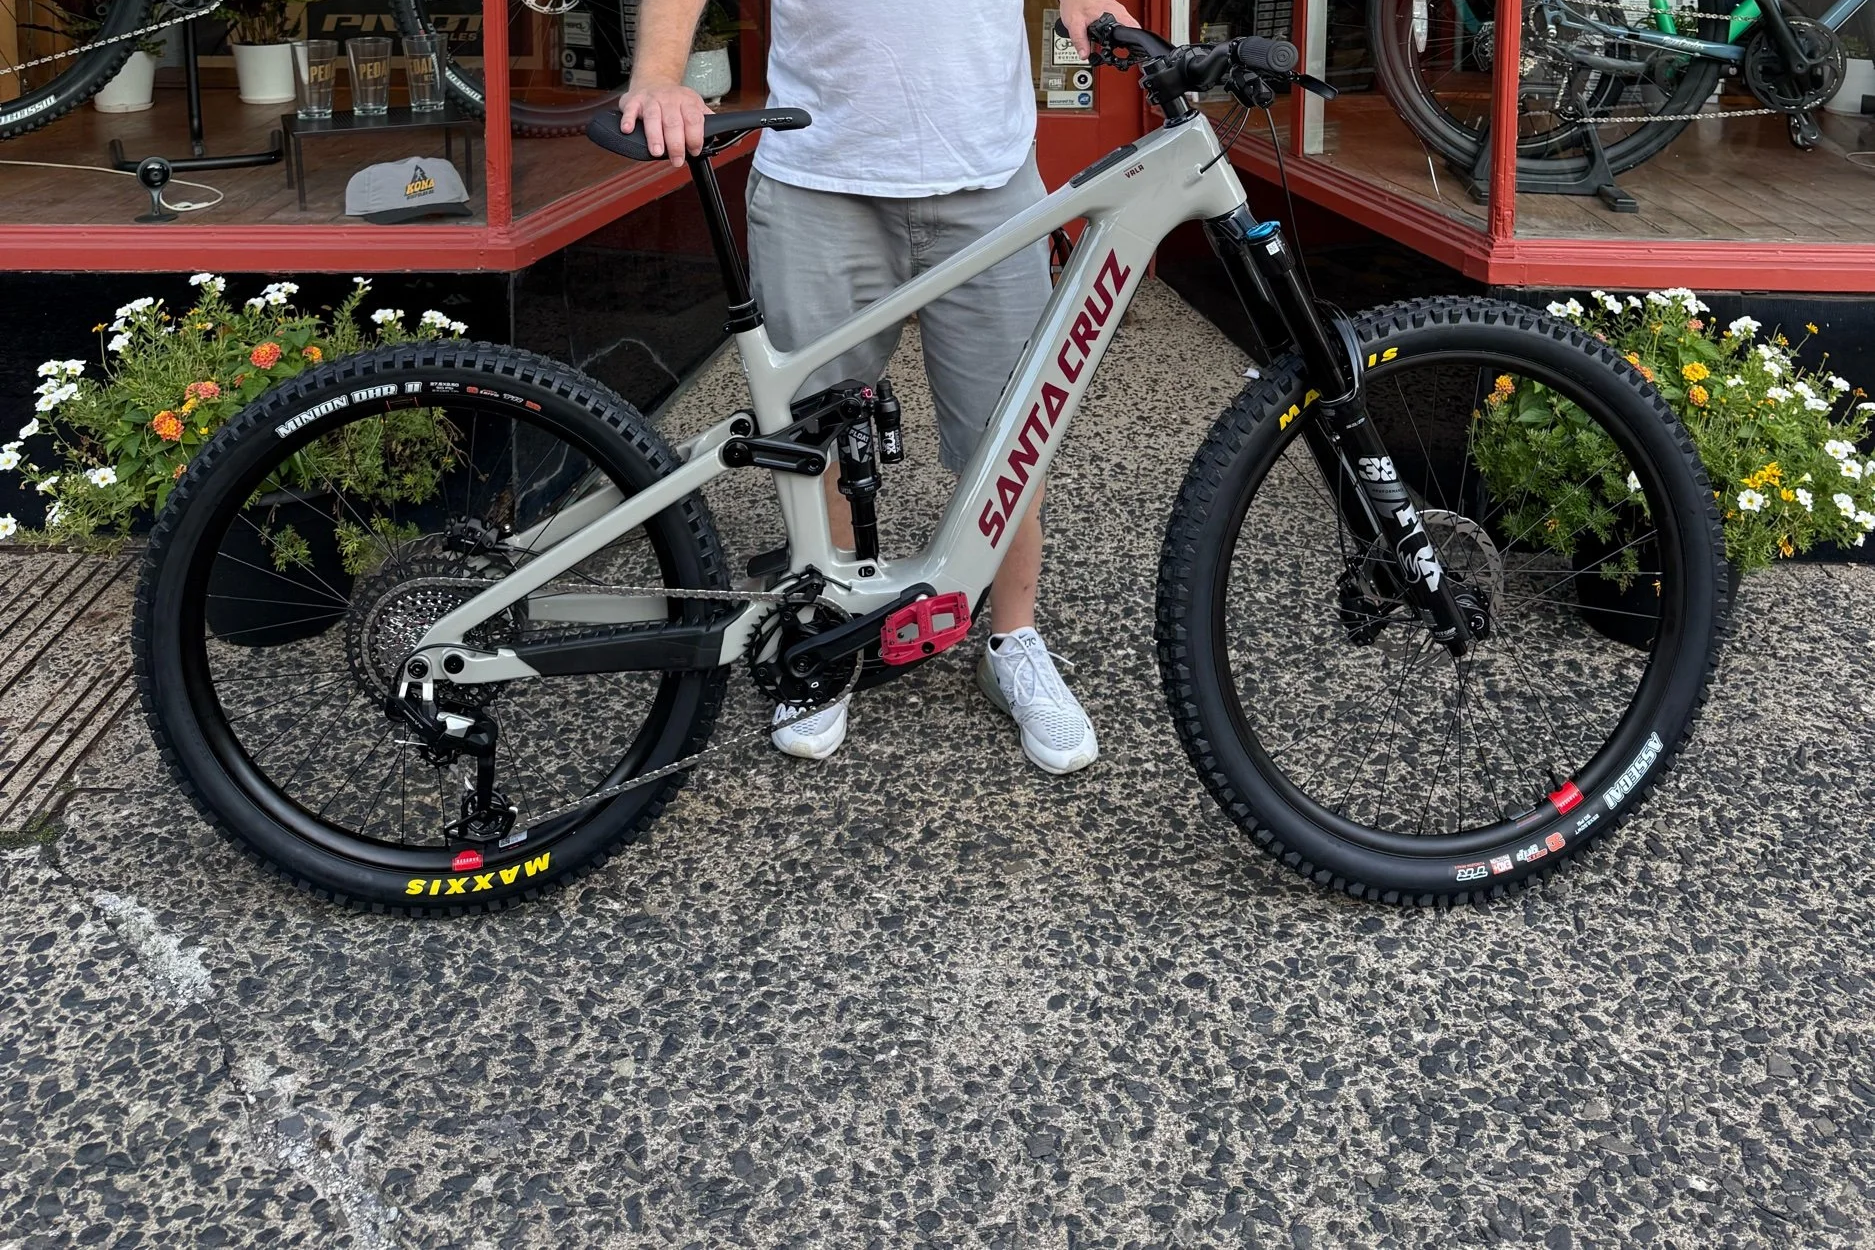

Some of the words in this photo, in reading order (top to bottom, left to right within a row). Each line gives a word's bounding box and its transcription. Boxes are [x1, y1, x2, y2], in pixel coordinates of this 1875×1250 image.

[406, 178, 435, 195] KONA
[275, 395, 350, 438] MINION
[978, 381, 1070, 550] SANTA
[1057, 248, 1131, 384] CRUZ
[849, 428, 869, 443] FLOAT
[1358, 455, 1397, 482] 38
[1602, 731, 1664, 810] ASSEGAI
[405, 852, 551, 896] MAXXIS
